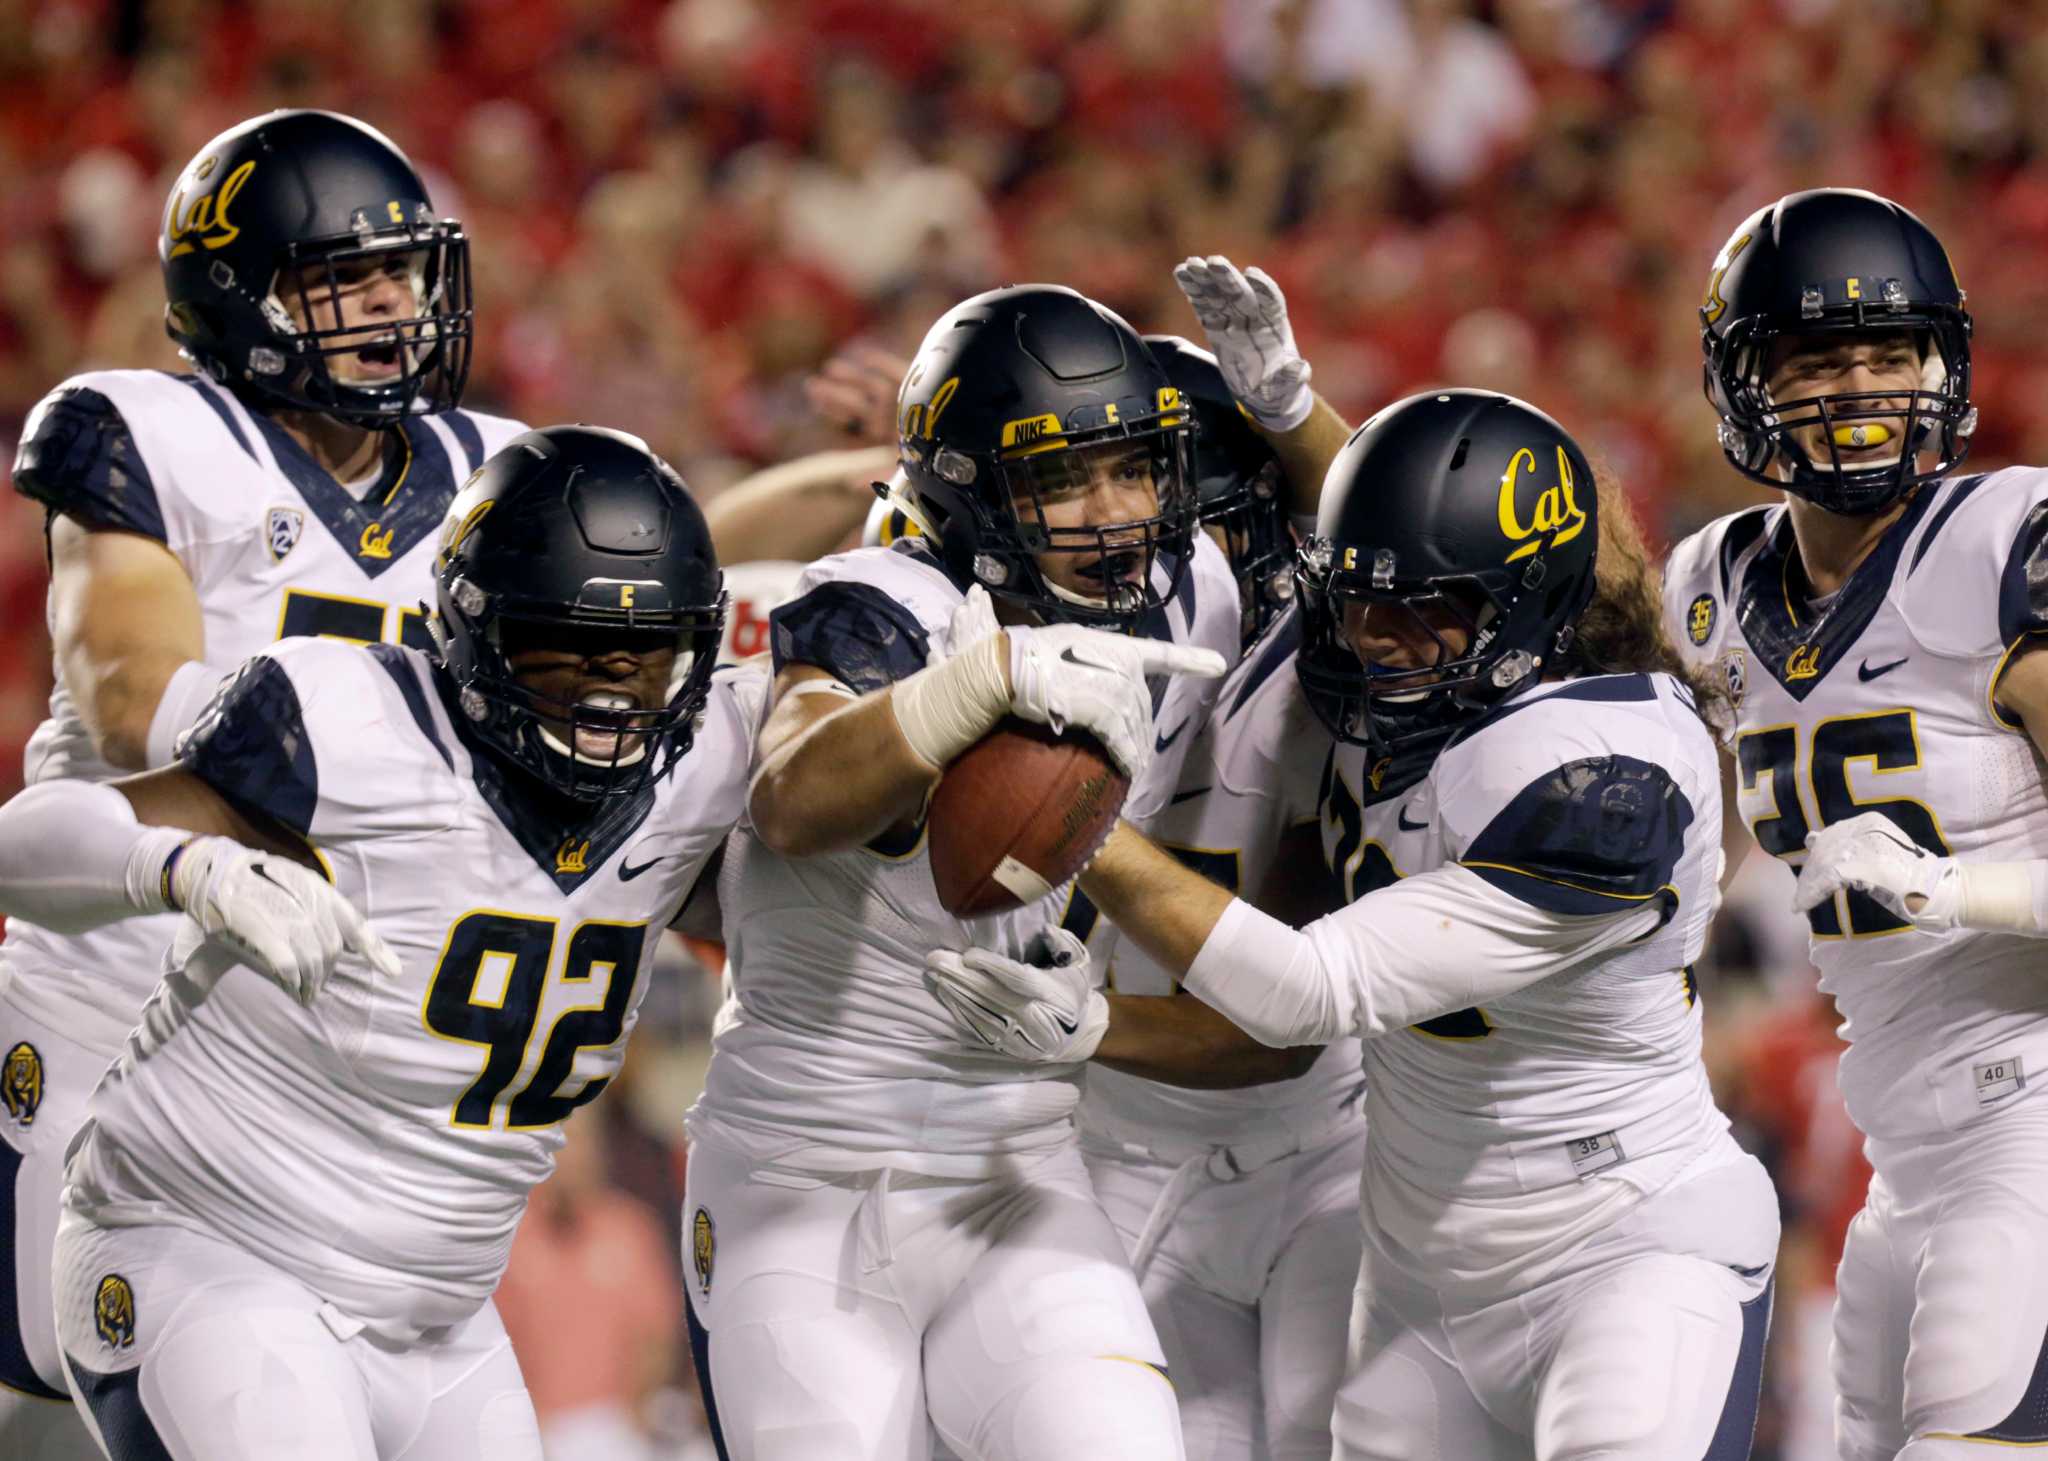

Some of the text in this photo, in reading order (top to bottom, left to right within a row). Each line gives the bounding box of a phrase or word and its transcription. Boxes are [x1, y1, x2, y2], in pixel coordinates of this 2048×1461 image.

[1014, 418, 1047, 443] NIKE
[1498, 445, 1586, 564] Cal
[357, 522, 394, 559] Cal
[1785, 643, 1821, 682] Cal
[555, 836, 590, 874] Cal
[421, 908, 651, 1132] 92
[1984, 1066, 2004, 1081] 40
[1579, 1136, 1600, 1154] 38
